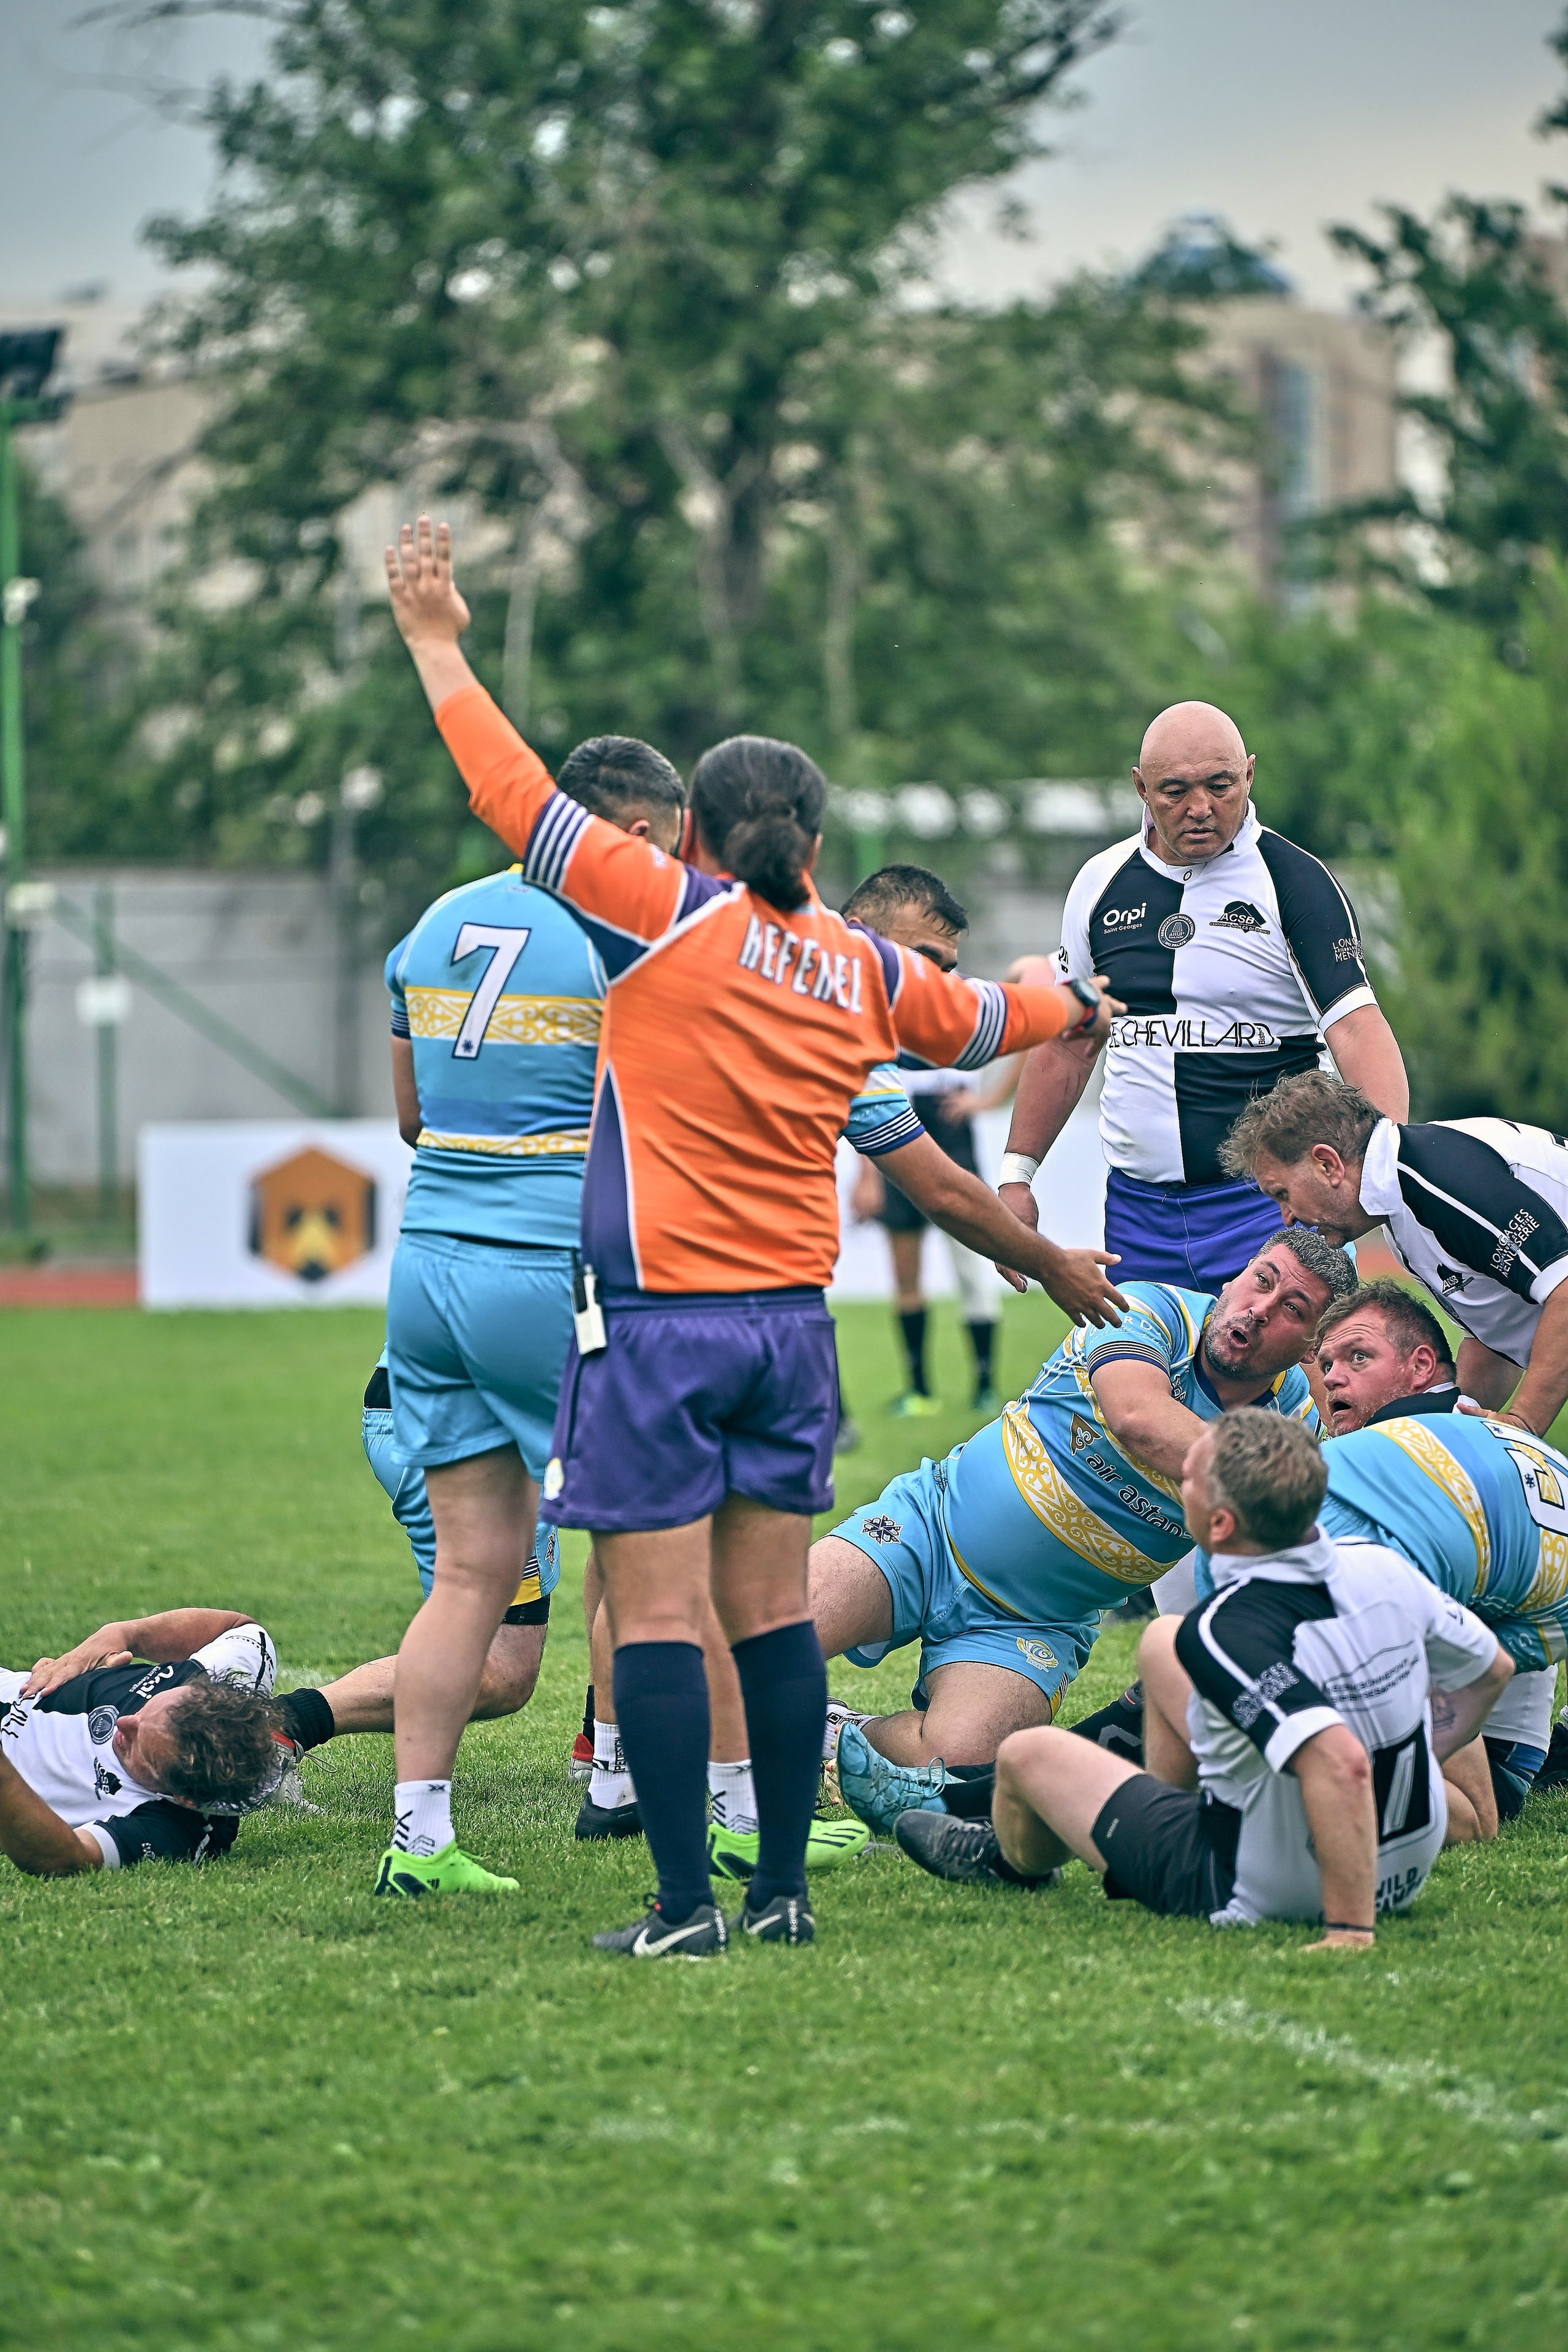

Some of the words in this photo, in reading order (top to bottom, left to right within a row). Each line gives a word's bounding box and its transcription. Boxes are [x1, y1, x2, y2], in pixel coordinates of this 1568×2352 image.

[1103, 902, 1147, 926] Orpi
[1220, 913, 1255, 924] ACSB
[448, 921, 536, 1060] 7
[1121, 1020, 1275, 1048] CHEVILLARD
[1490, 1208, 1530, 1270] LONGAGES
[1086, 1453, 1123, 1483] air
